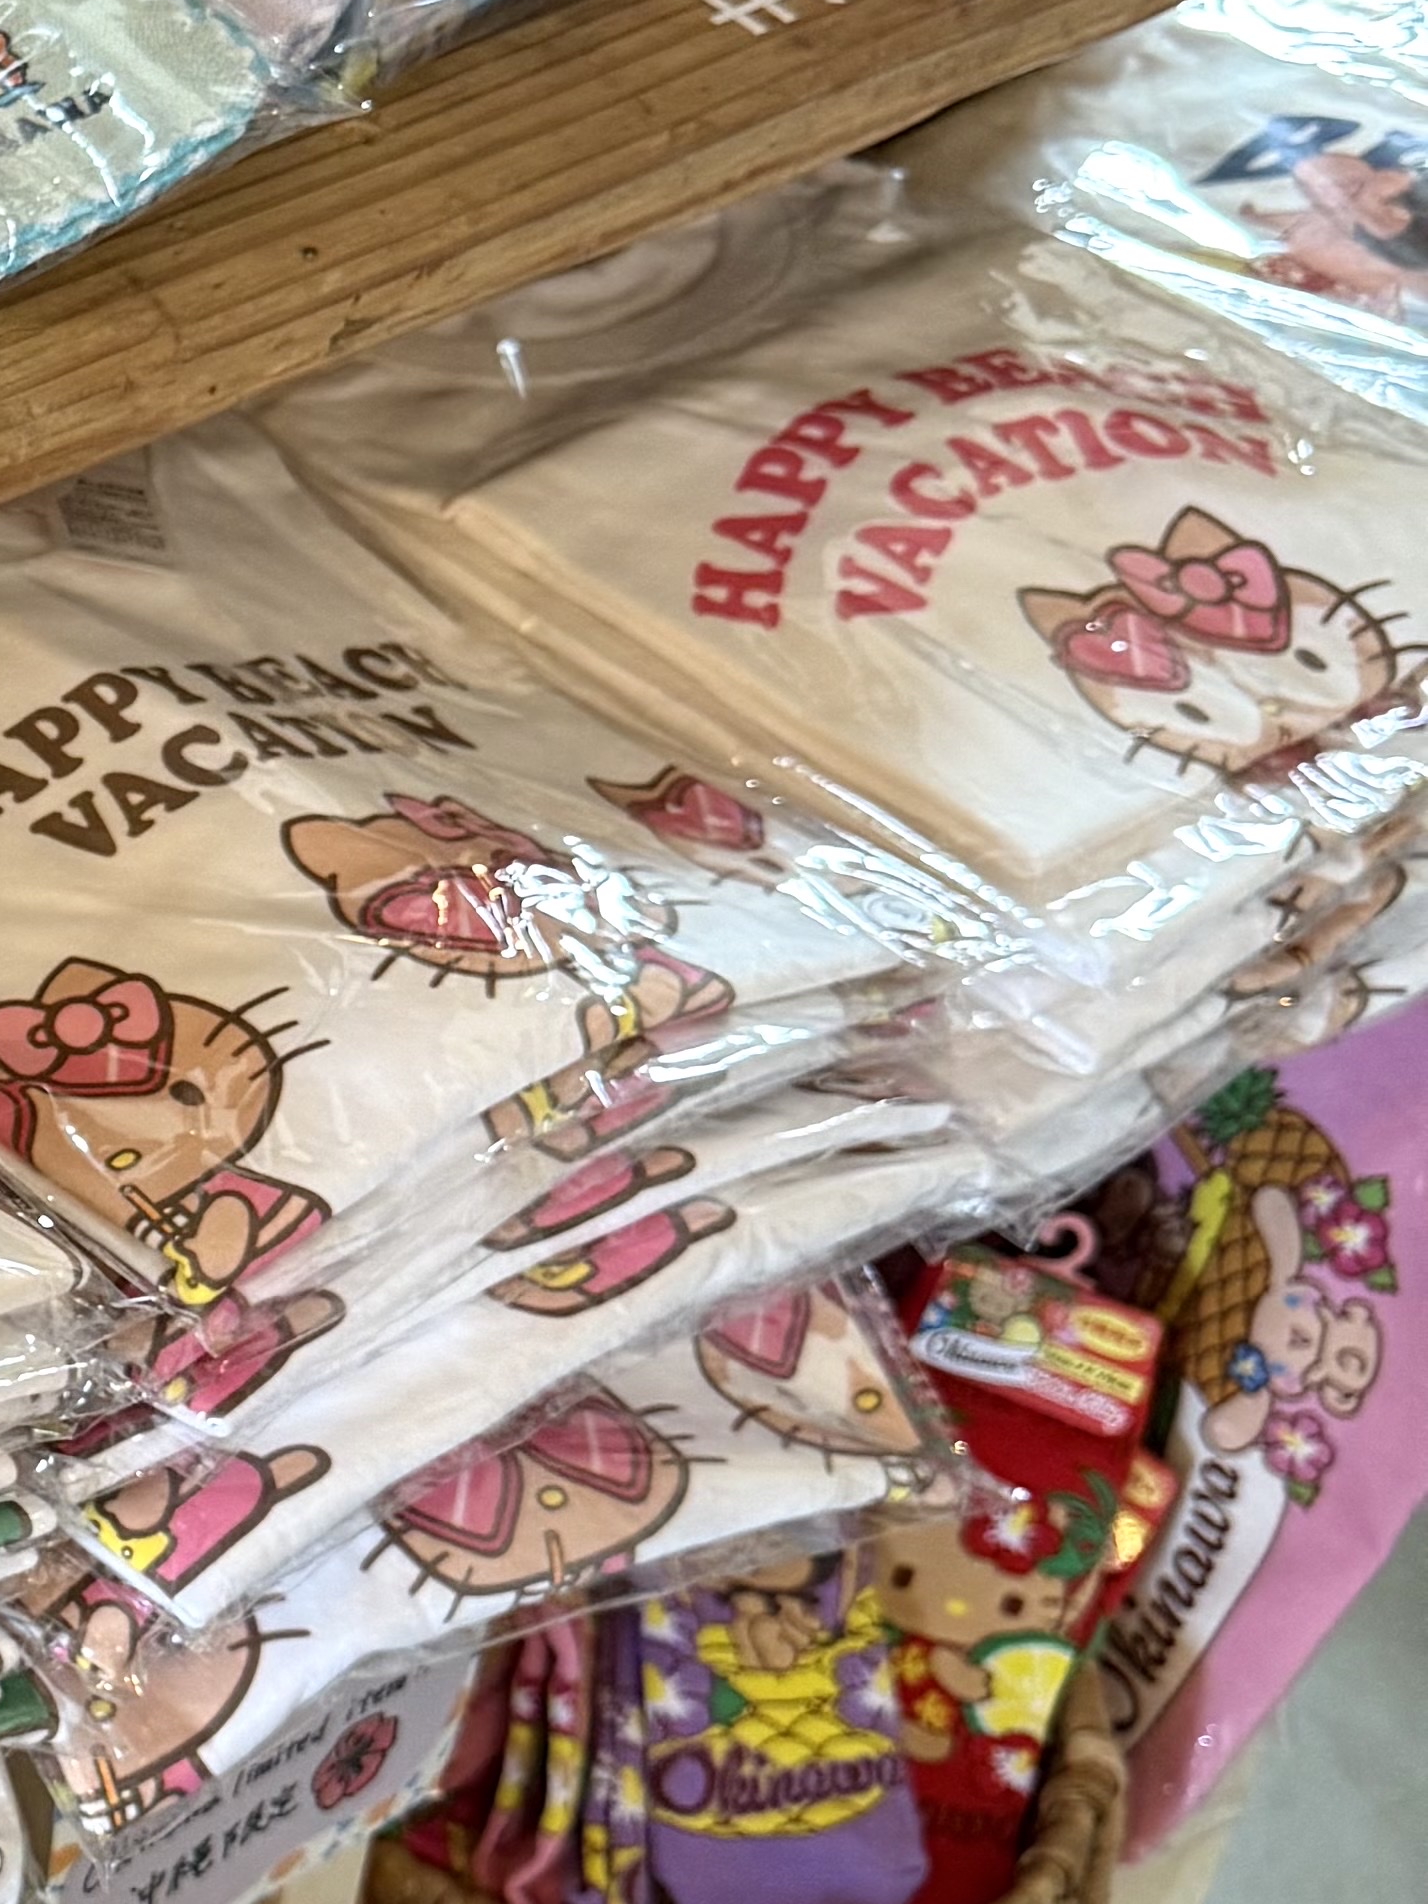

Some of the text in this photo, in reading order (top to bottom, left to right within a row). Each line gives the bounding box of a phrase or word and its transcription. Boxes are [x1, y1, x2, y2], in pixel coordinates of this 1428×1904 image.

[692, 386, 915, 630] HAPPY
[835, 407, 1278, 621] VACATION
[23, 700, 483, 864] VACATION
[647, 1740, 917, 1818] Okinawa
